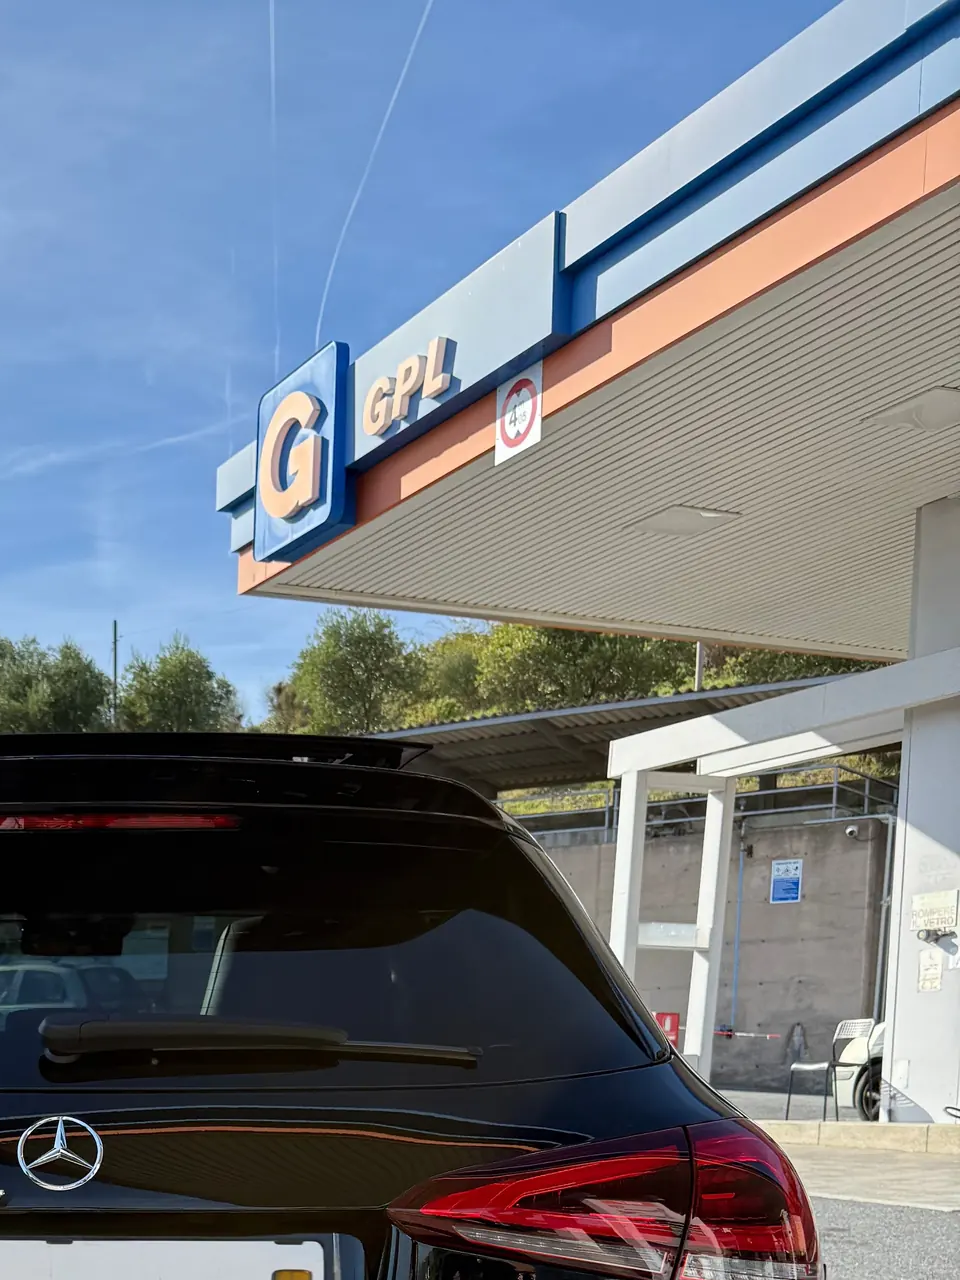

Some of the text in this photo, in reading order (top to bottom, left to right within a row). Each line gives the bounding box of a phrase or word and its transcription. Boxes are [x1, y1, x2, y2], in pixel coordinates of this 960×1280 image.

[362, 336, 457, 436] GPL
[259, 391, 322, 518] G
[923, 916, 954, 928] VETRO
